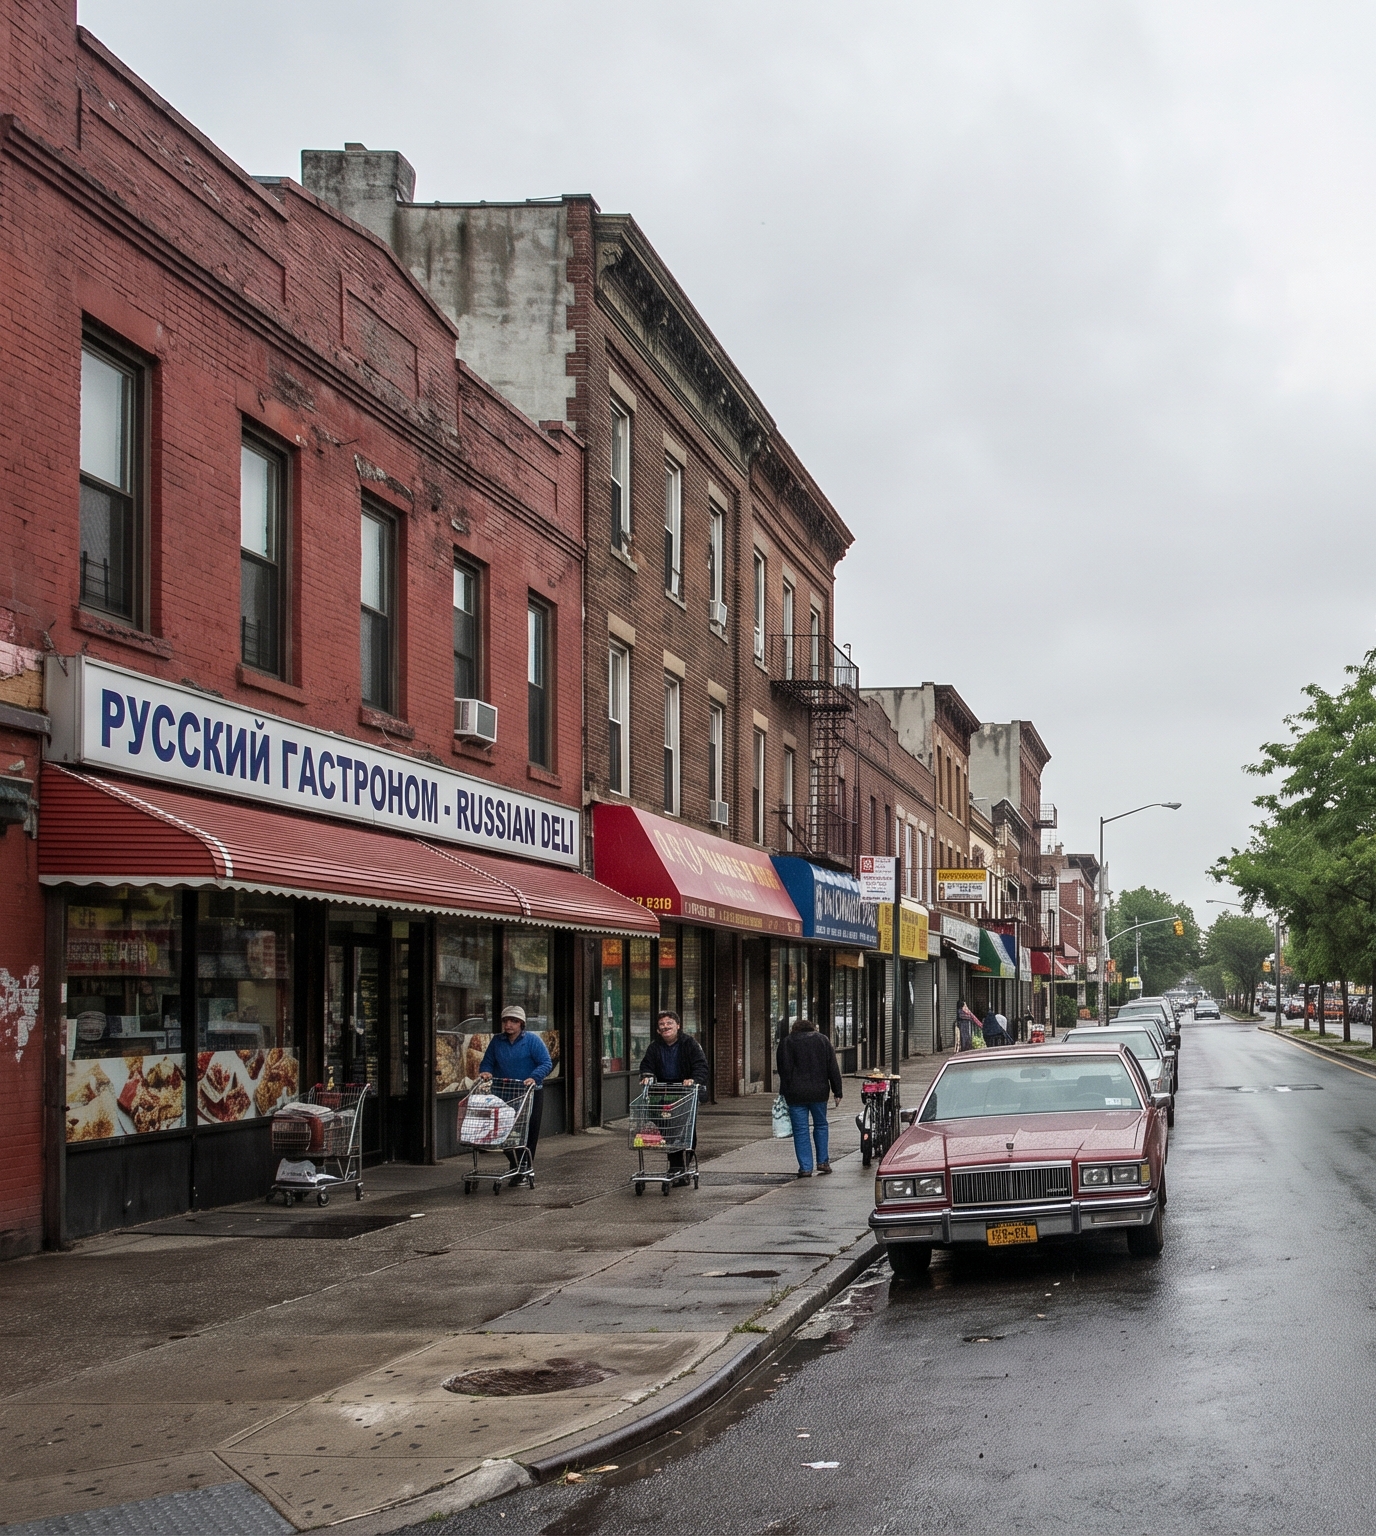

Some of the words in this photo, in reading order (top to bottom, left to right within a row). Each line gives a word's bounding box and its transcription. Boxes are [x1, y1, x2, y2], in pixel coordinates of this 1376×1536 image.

[101, 688, 270, 786] РУССКИЙ
[281, 739, 439, 825] ГАСТРОНОМ
[456, 788, 536, 846] RUSSIAN
[541, 811, 574, 856] DELI
